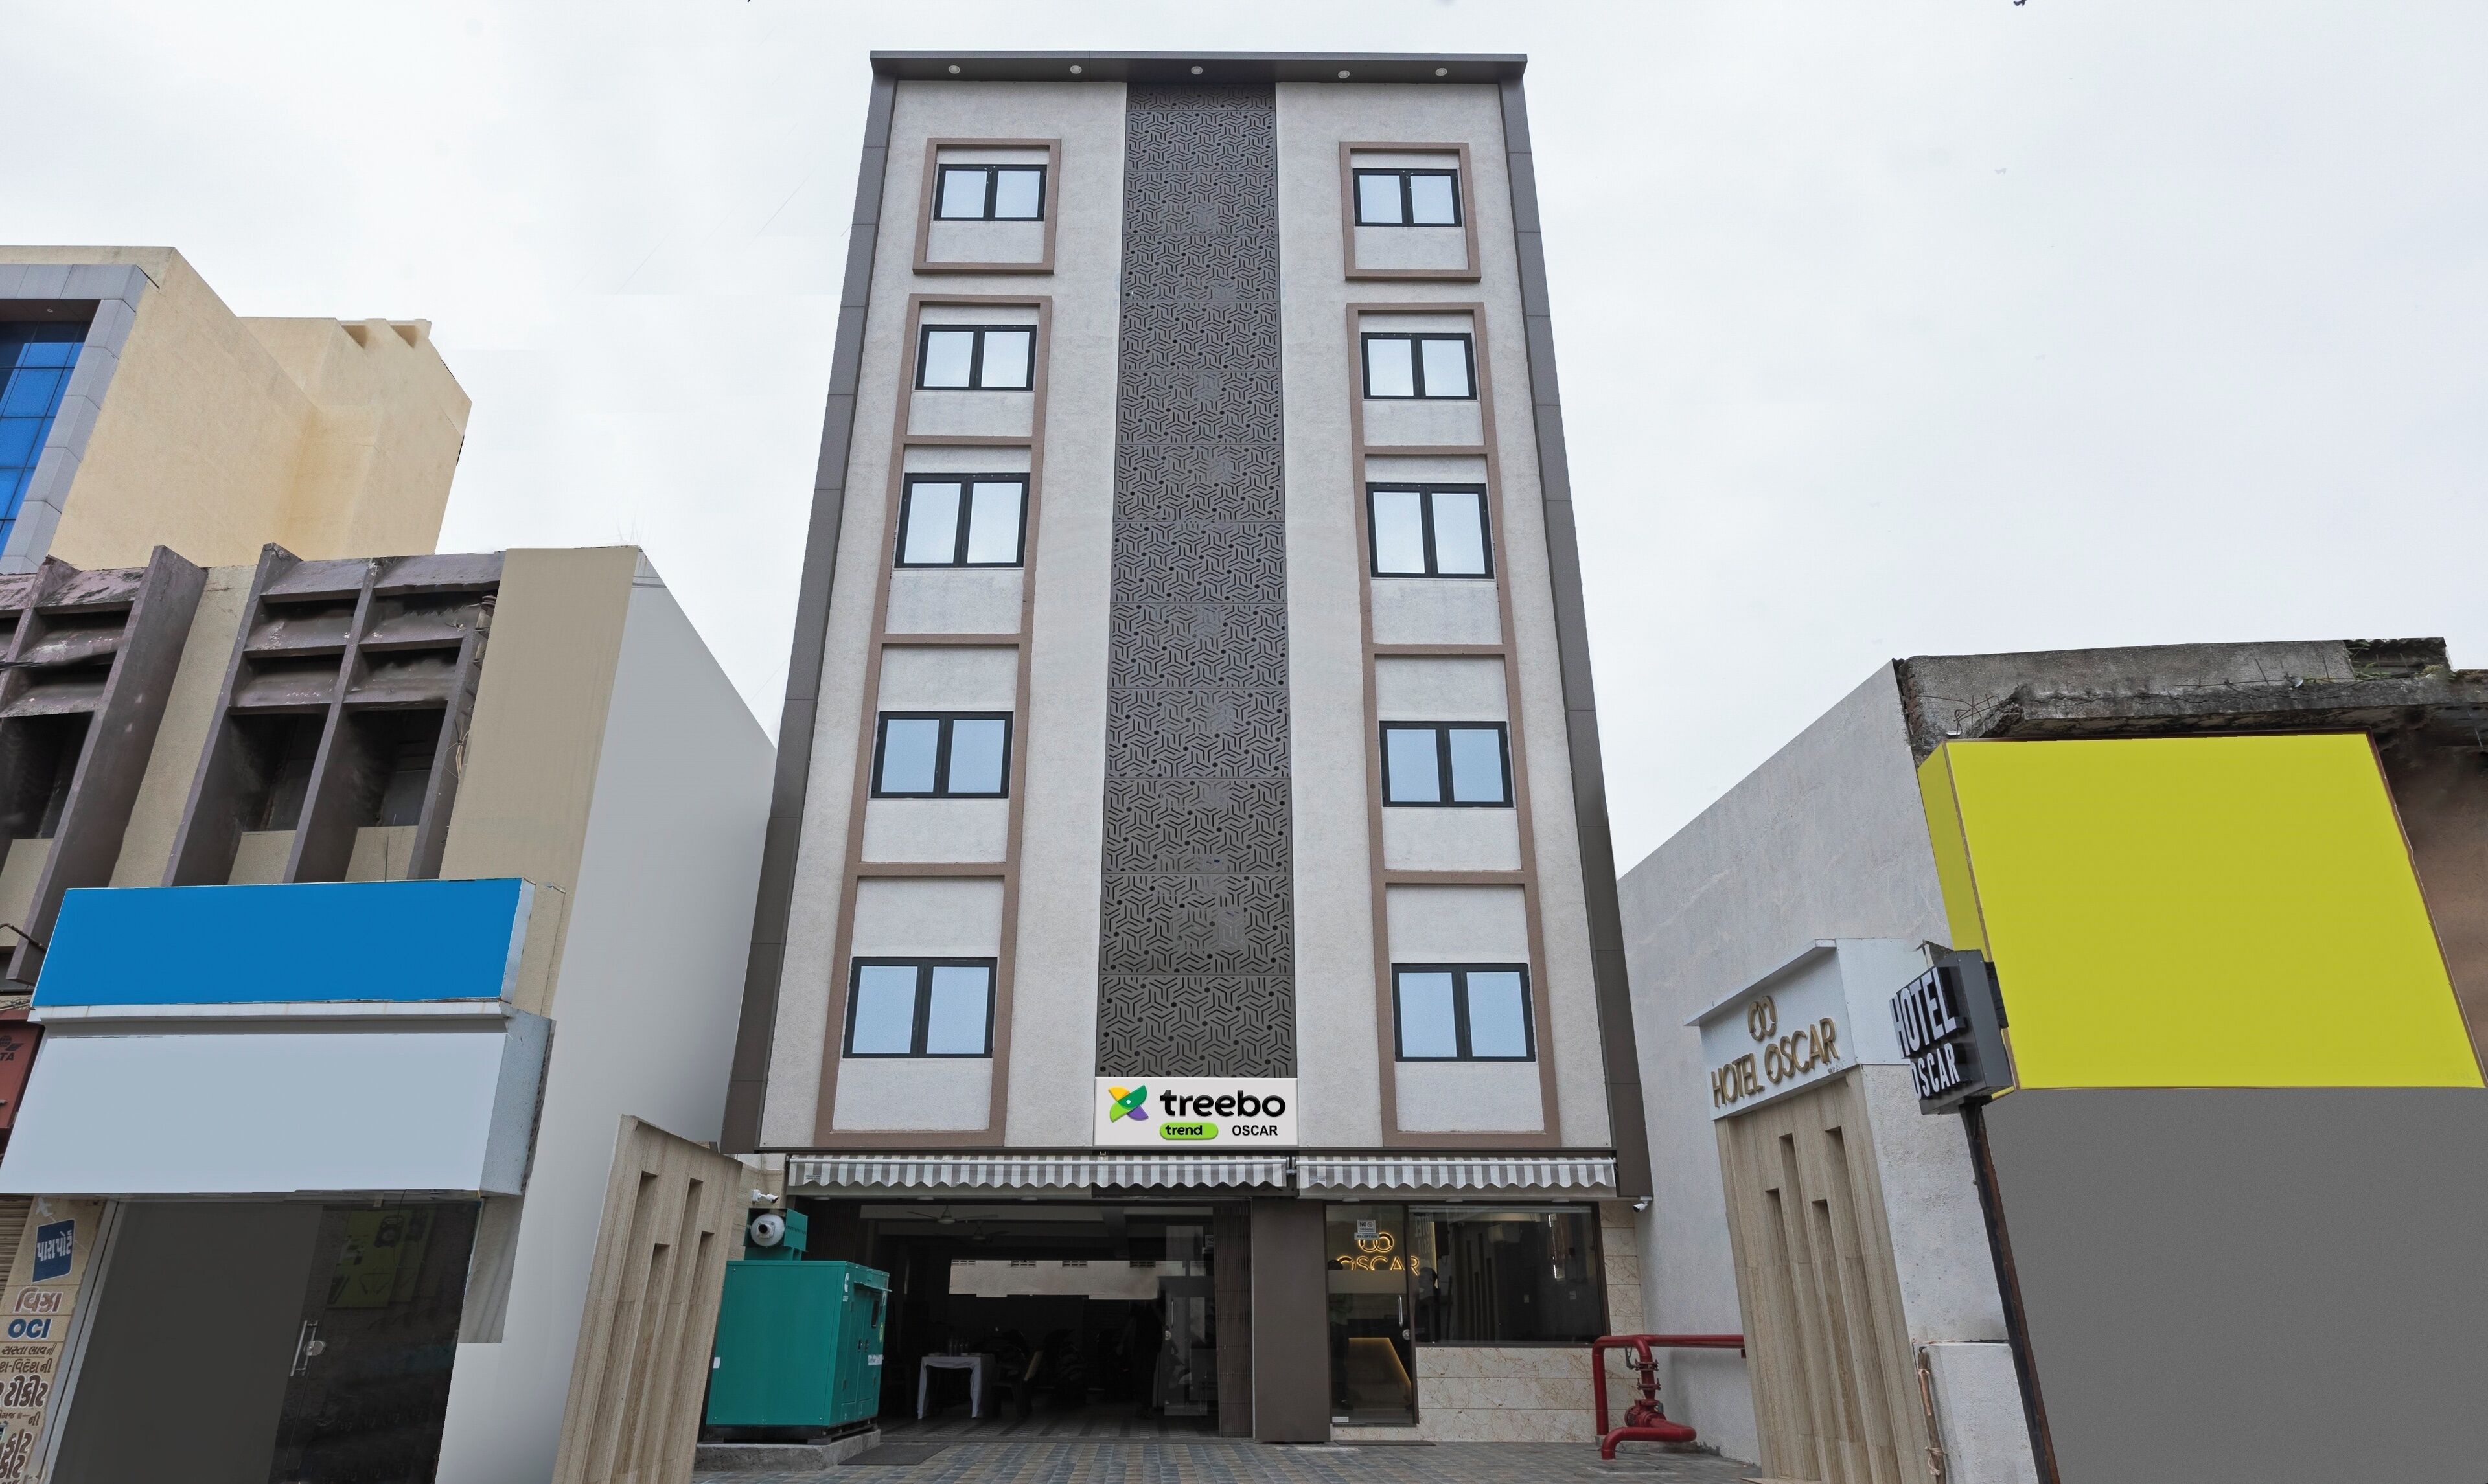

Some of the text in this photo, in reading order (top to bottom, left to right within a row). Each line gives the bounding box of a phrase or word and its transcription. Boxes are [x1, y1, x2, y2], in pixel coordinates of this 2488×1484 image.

[1890, 967, 1957, 1058] HOTEL
[1711, 1018, 1840, 1108] HOTEL OSCAR
[1911, 1042, 1960, 1100] OSCAR
[1160, 1090, 1286, 1117] treebo
[1165, 1125, 1278, 1136] trend OSCAR
[8, 1318, 52, 1340] OCI
